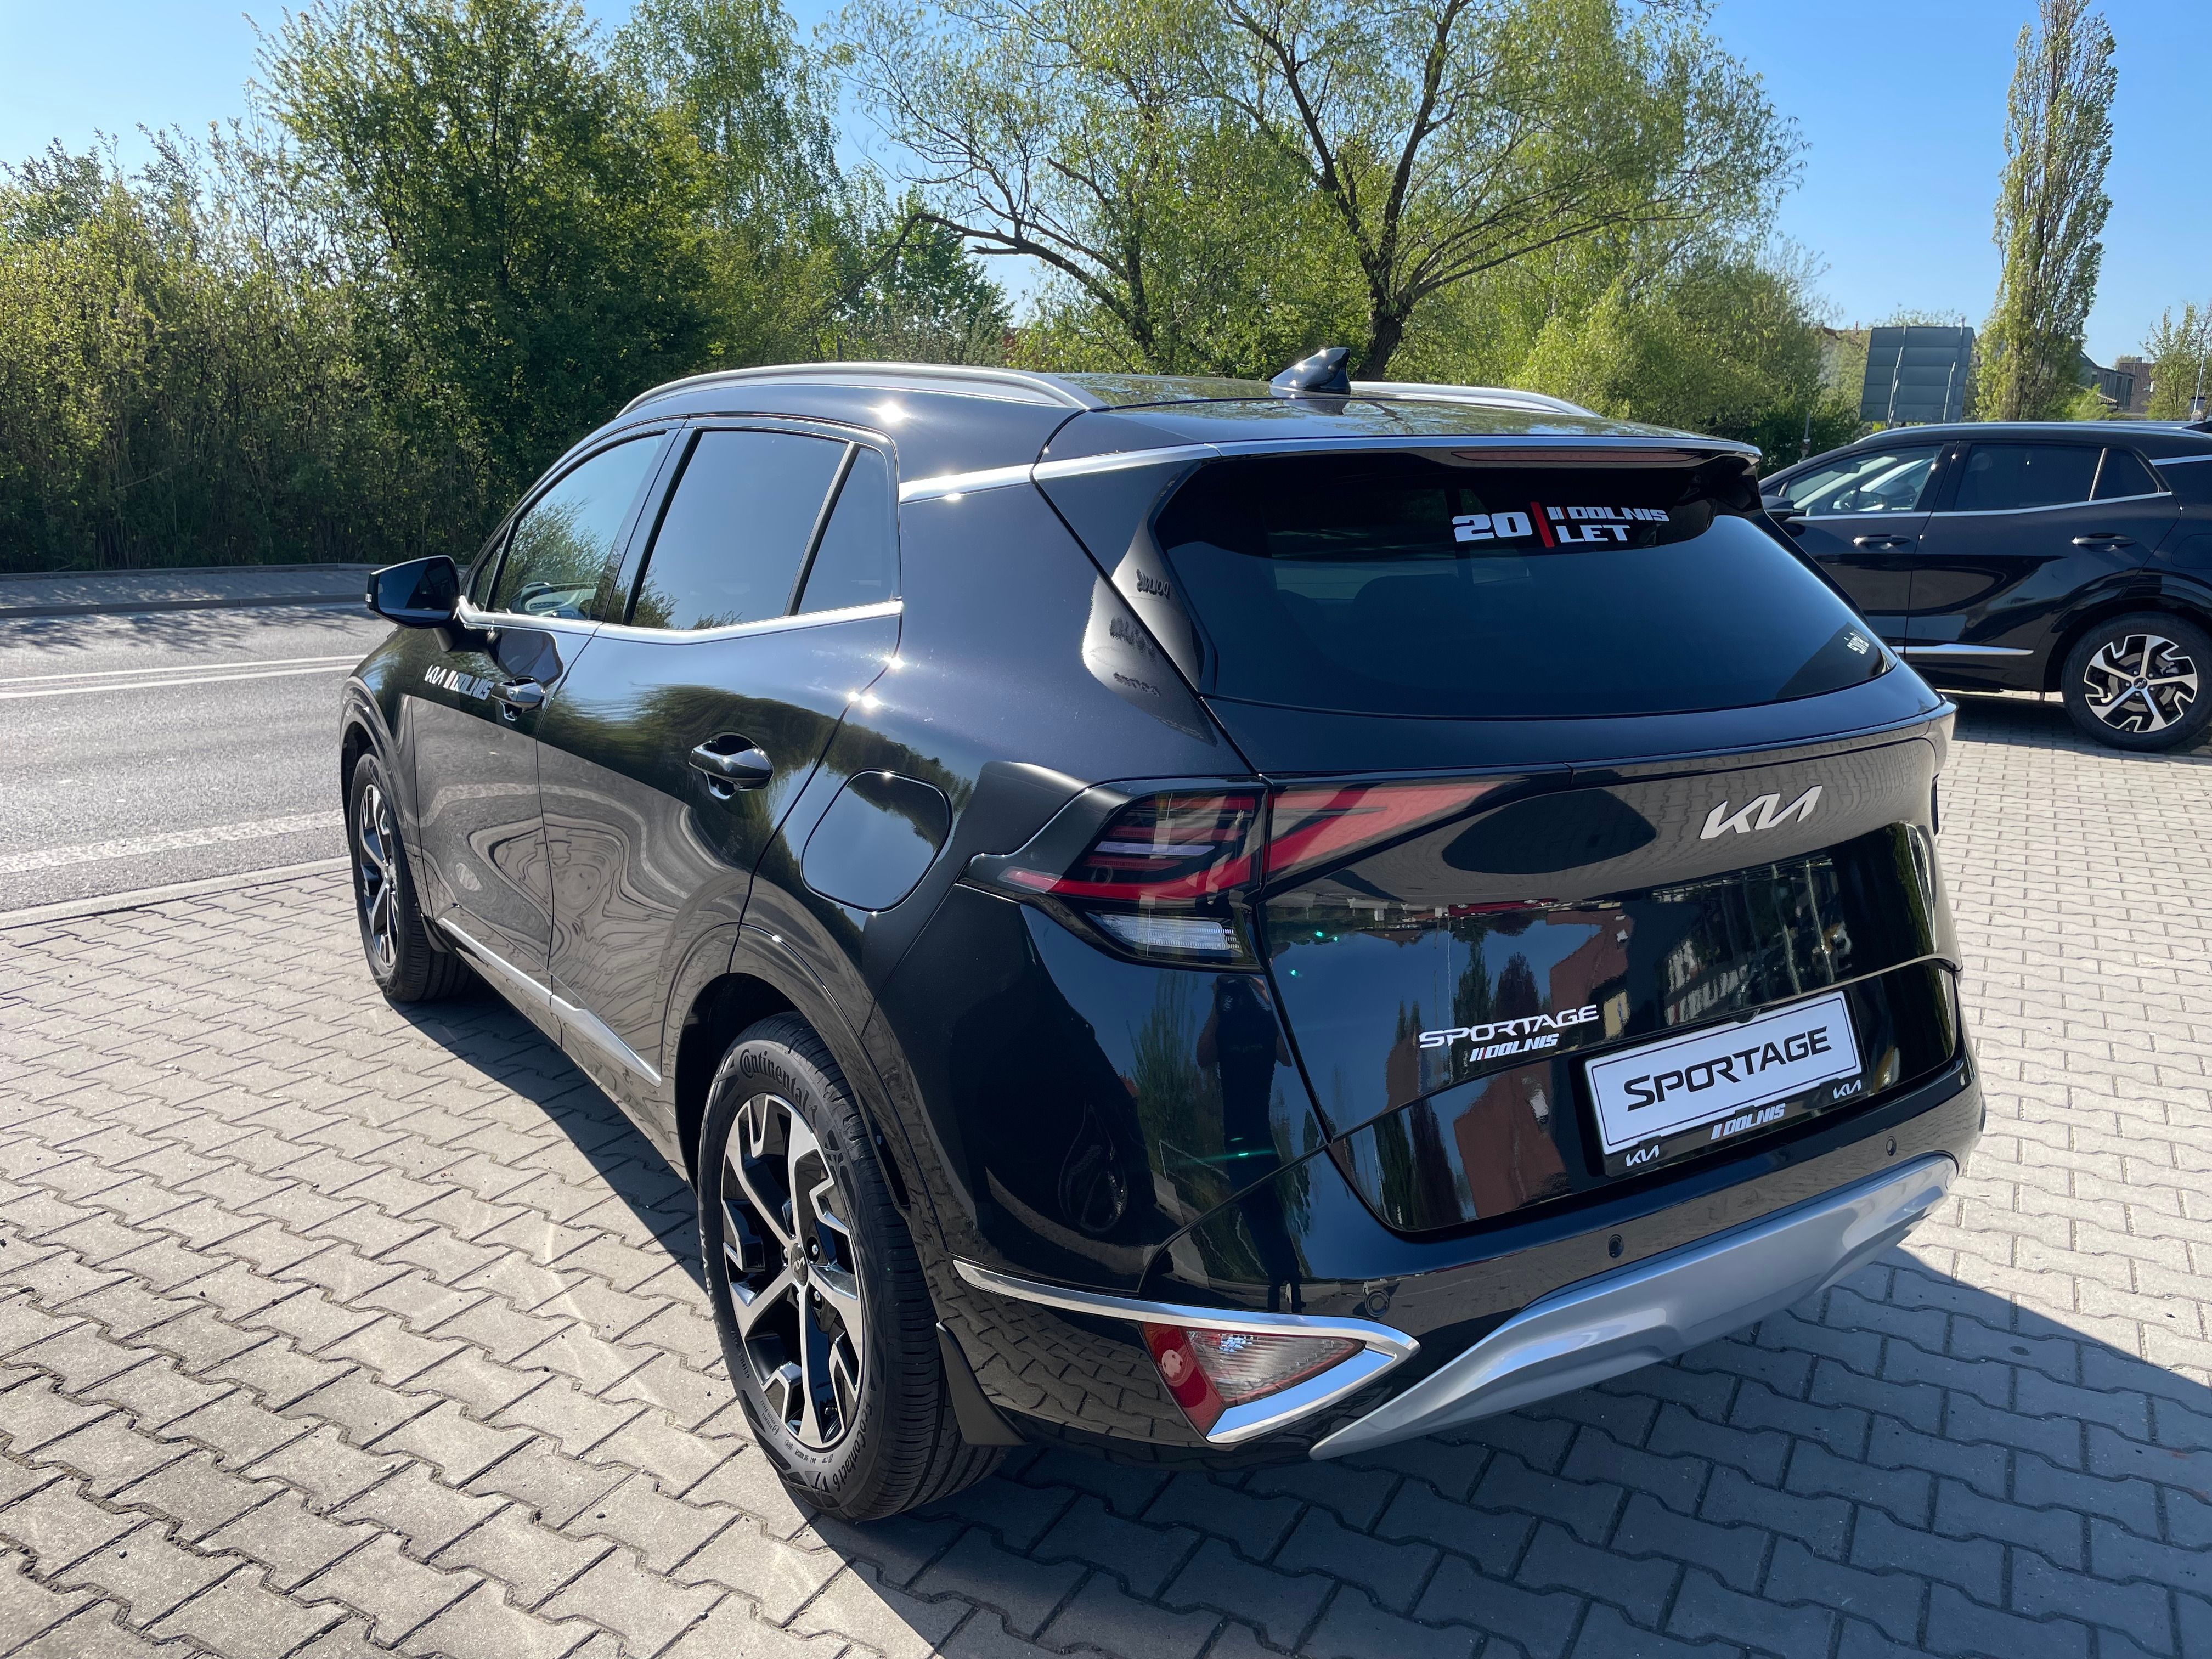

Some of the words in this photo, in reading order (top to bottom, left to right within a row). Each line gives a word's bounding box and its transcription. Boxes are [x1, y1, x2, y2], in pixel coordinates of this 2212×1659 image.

[1452, 511, 1533, 543] 20
[1556, 524, 1630, 543] LET
[1700, 785, 1823, 840] KIA
[1419, 1004, 1599, 1049] SPORTAGE
[740, 1048, 810, 1114] Continental
[1624, 1025, 1833, 1113] SPORTAGE
[1626, 1144, 1660, 1167] KIA
[1833, 1079, 1862, 1099] KIA
